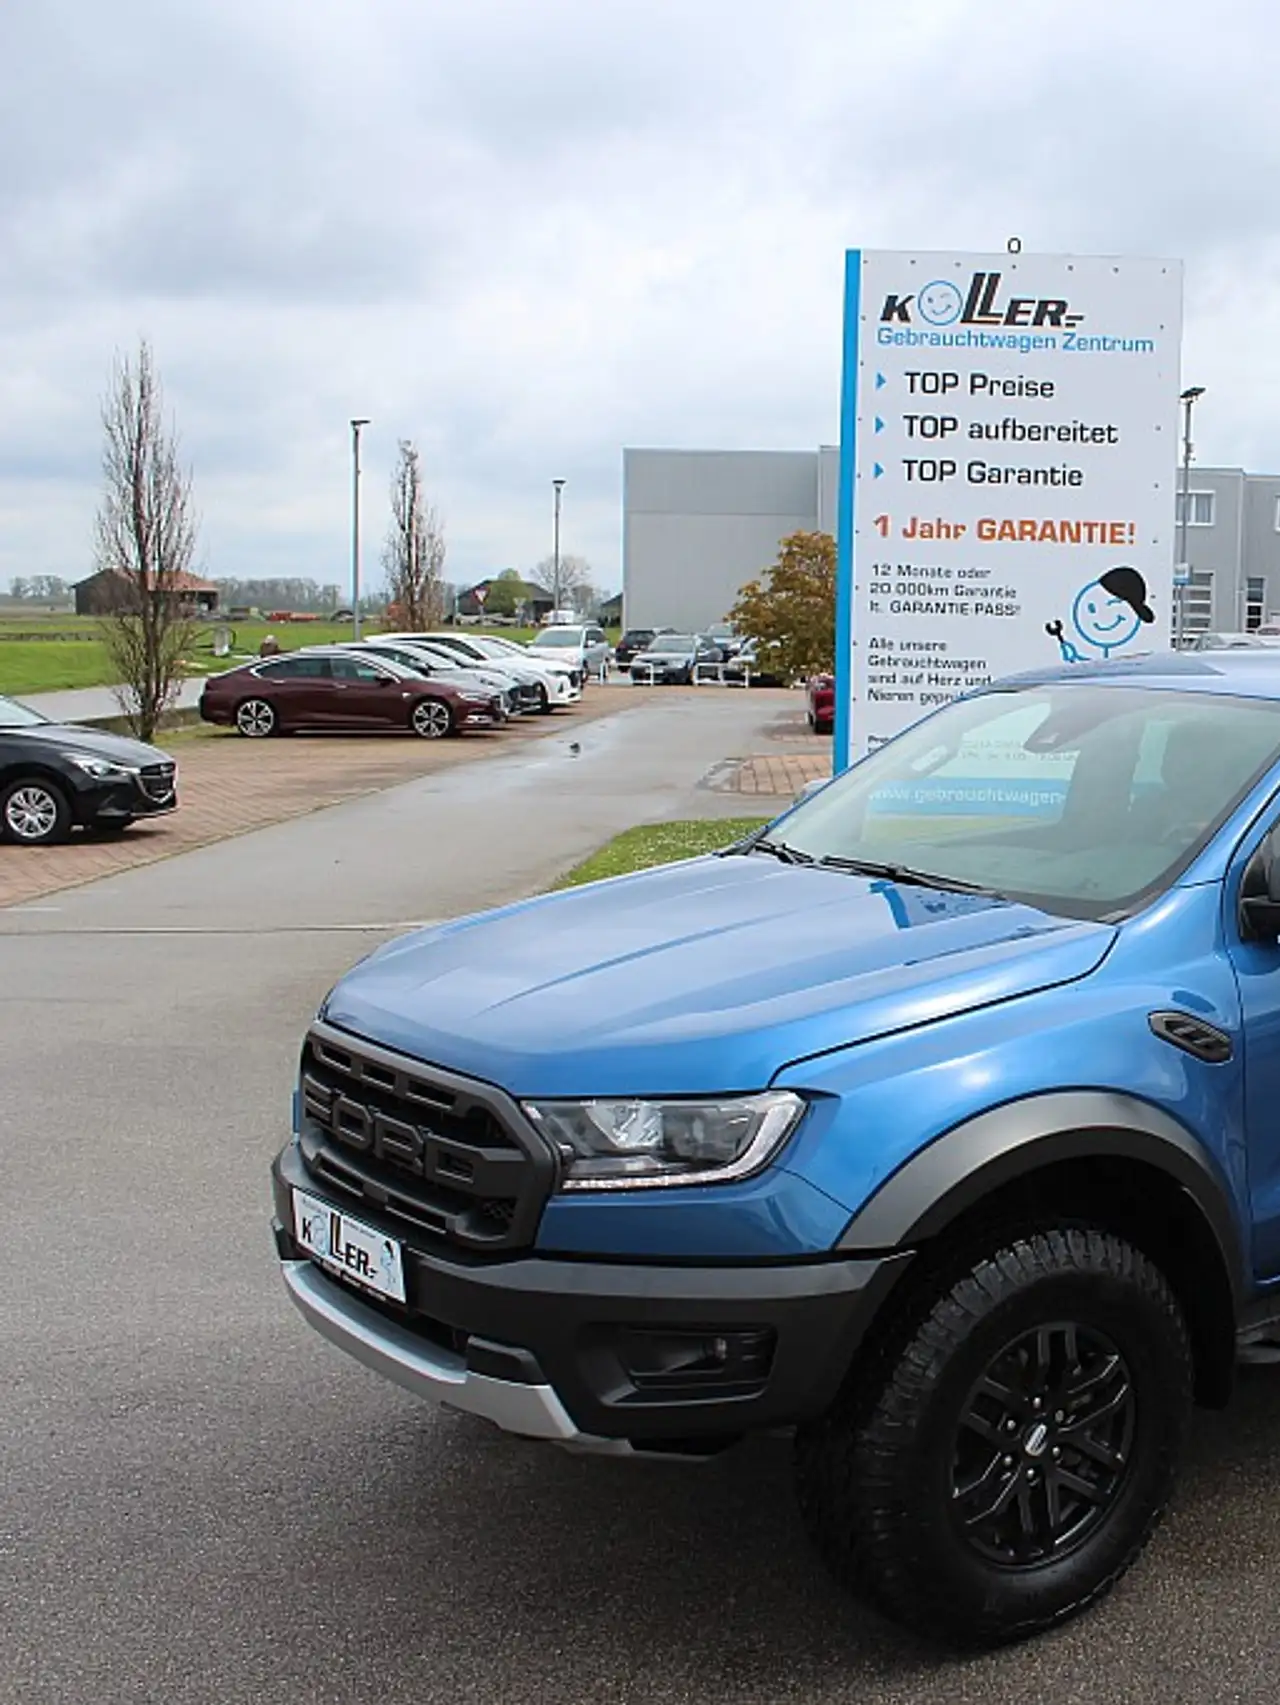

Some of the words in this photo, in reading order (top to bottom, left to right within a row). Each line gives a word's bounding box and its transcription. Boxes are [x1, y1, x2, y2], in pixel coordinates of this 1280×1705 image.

[877, 327, 1056, 353] Gebrauchtwagen
[1062, 332, 1154, 352] Zentrum
[905, 372, 959, 395] TOP
[969, 373, 1055, 398] Preise
[903, 416, 958, 438] TOP
[968, 418, 1119, 444] aufbereitet
[902, 460, 957, 482] TOP
[966, 461, 1084, 486] Garantie
[873, 515, 890, 538] 1
[902, 517, 967, 540] Jahr
[976, 519, 1136, 545] GARANTIE!
[872, 564, 892, 576] 12
[897, 565, 952, 579] Monate
[957, 568, 992, 579] oder
[954, 585, 1017, 598] Garantie
[869, 637, 895, 651] Alle
[899, 641, 948, 651] unsere
[867, 655, 987, 672] Gebrauchtwagen
[868, 673, 896, 684] sind
[928, 674, 962, 686] Herz
[304, 1073, 475, 1190] FORD
